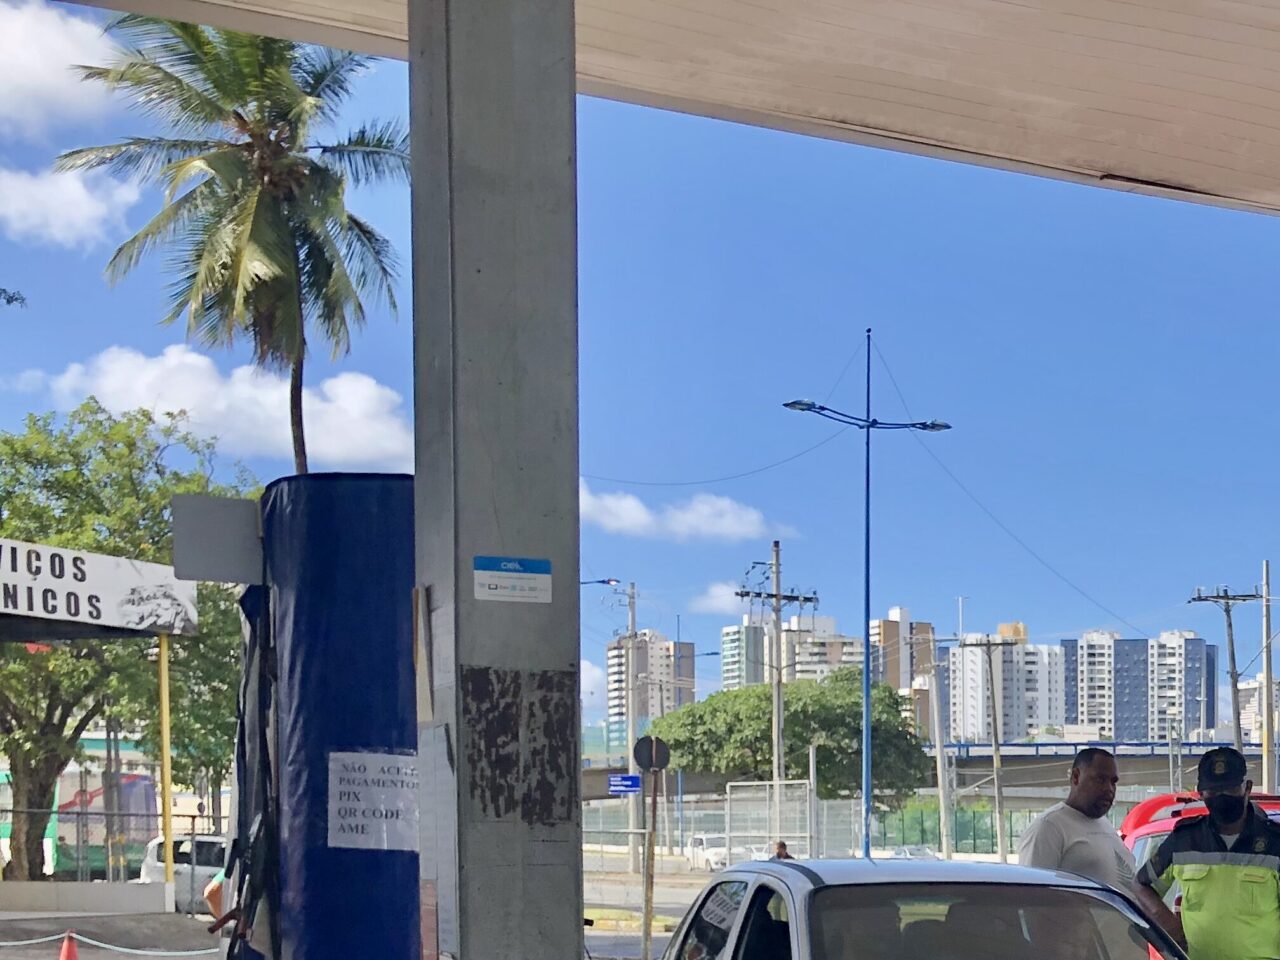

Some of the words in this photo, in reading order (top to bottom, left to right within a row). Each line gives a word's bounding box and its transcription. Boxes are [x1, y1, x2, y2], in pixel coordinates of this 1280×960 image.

[0, 545, 87, 582] IÇOS
[3, 583, 102, 620] NICOS
[338, 790, 361, 802] PIX
[337, 806, 357, 819] QR
[361, 808, 403, 820] CODE
[337, 823, 369, 835] AME
